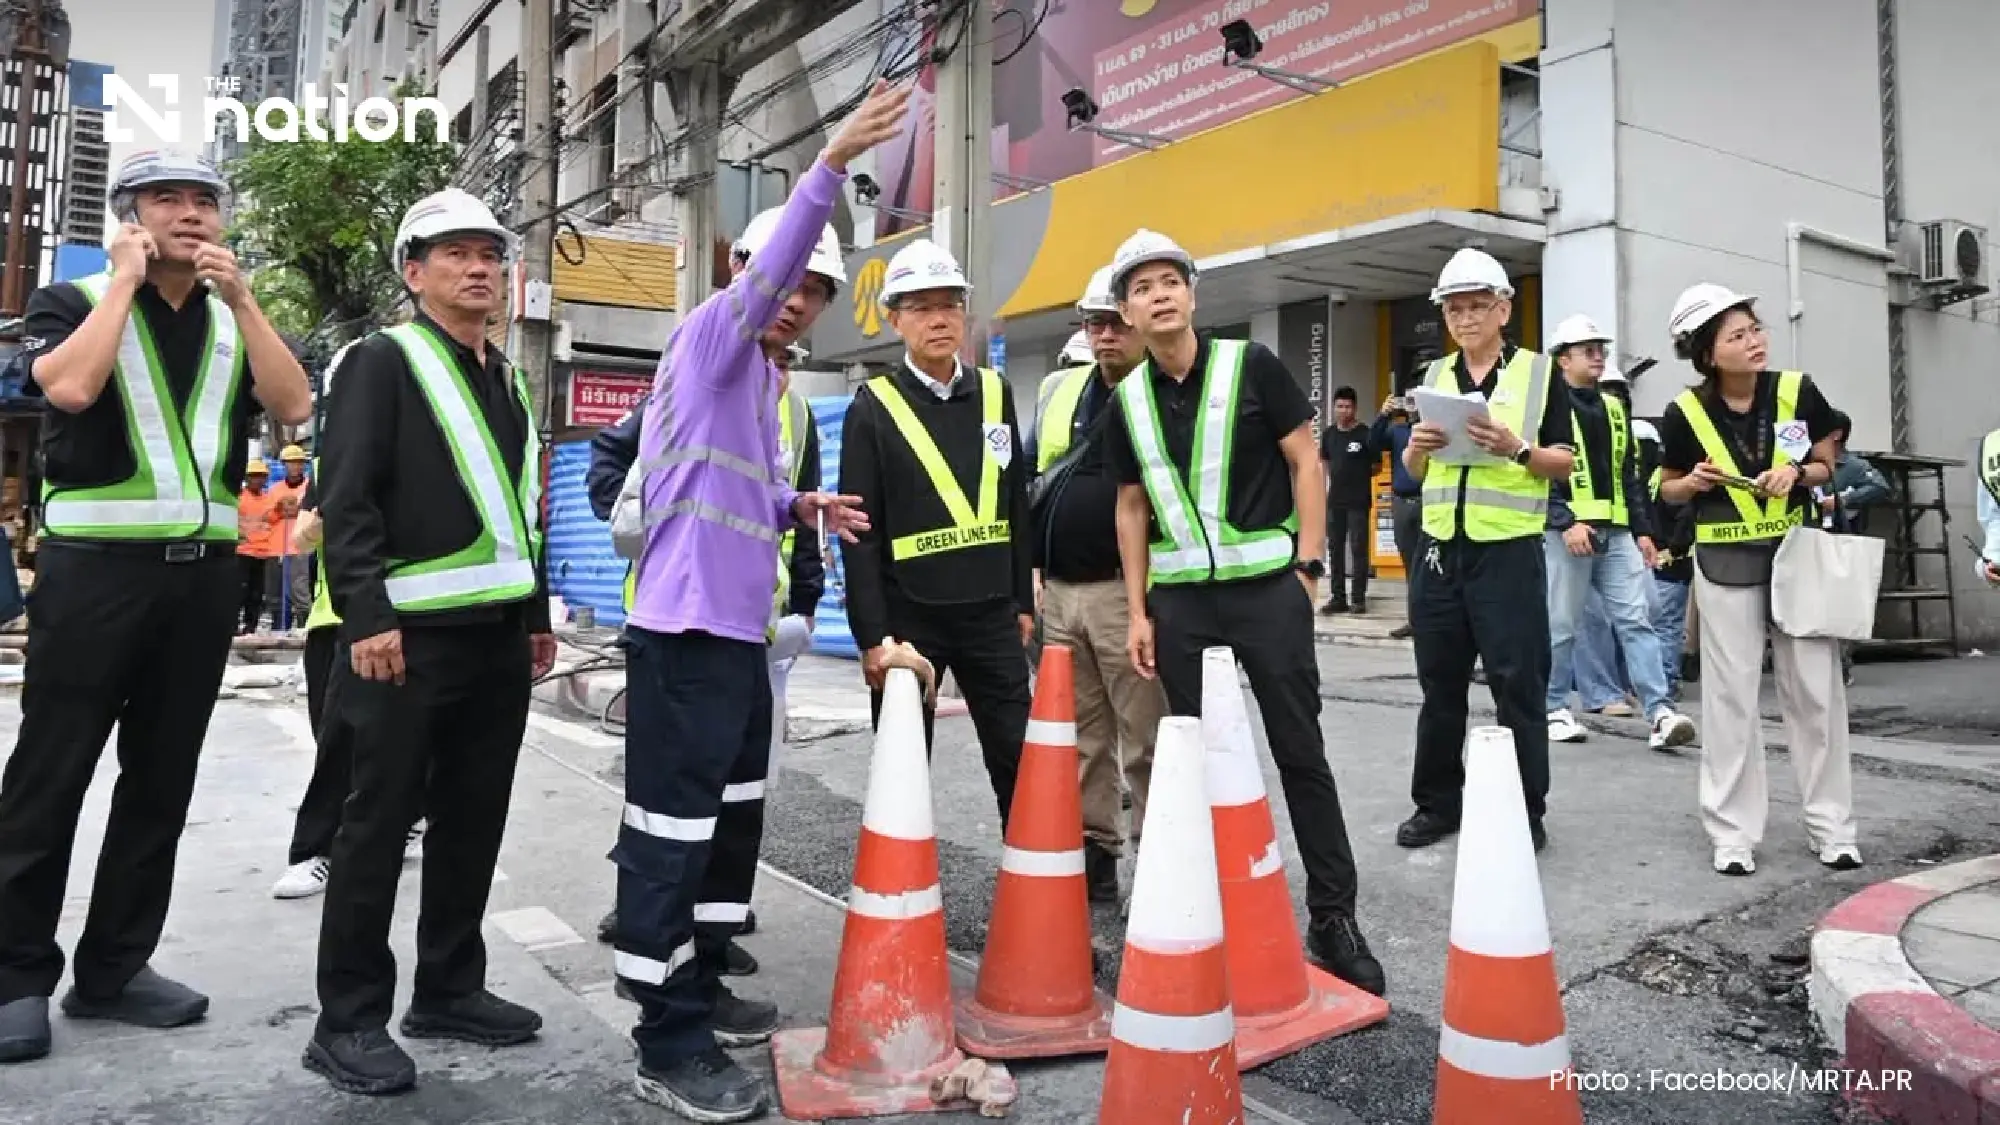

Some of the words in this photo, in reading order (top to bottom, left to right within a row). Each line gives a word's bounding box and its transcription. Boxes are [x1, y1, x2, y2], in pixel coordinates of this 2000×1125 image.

[1202, 11, 1219, 30] 70
[1308, 323, 1324, 402] banking
[917, 531, 957, 552] GREEN
[960, 525, 986, 543] LINE
[1712, 525, 1750, 539] MRTA
